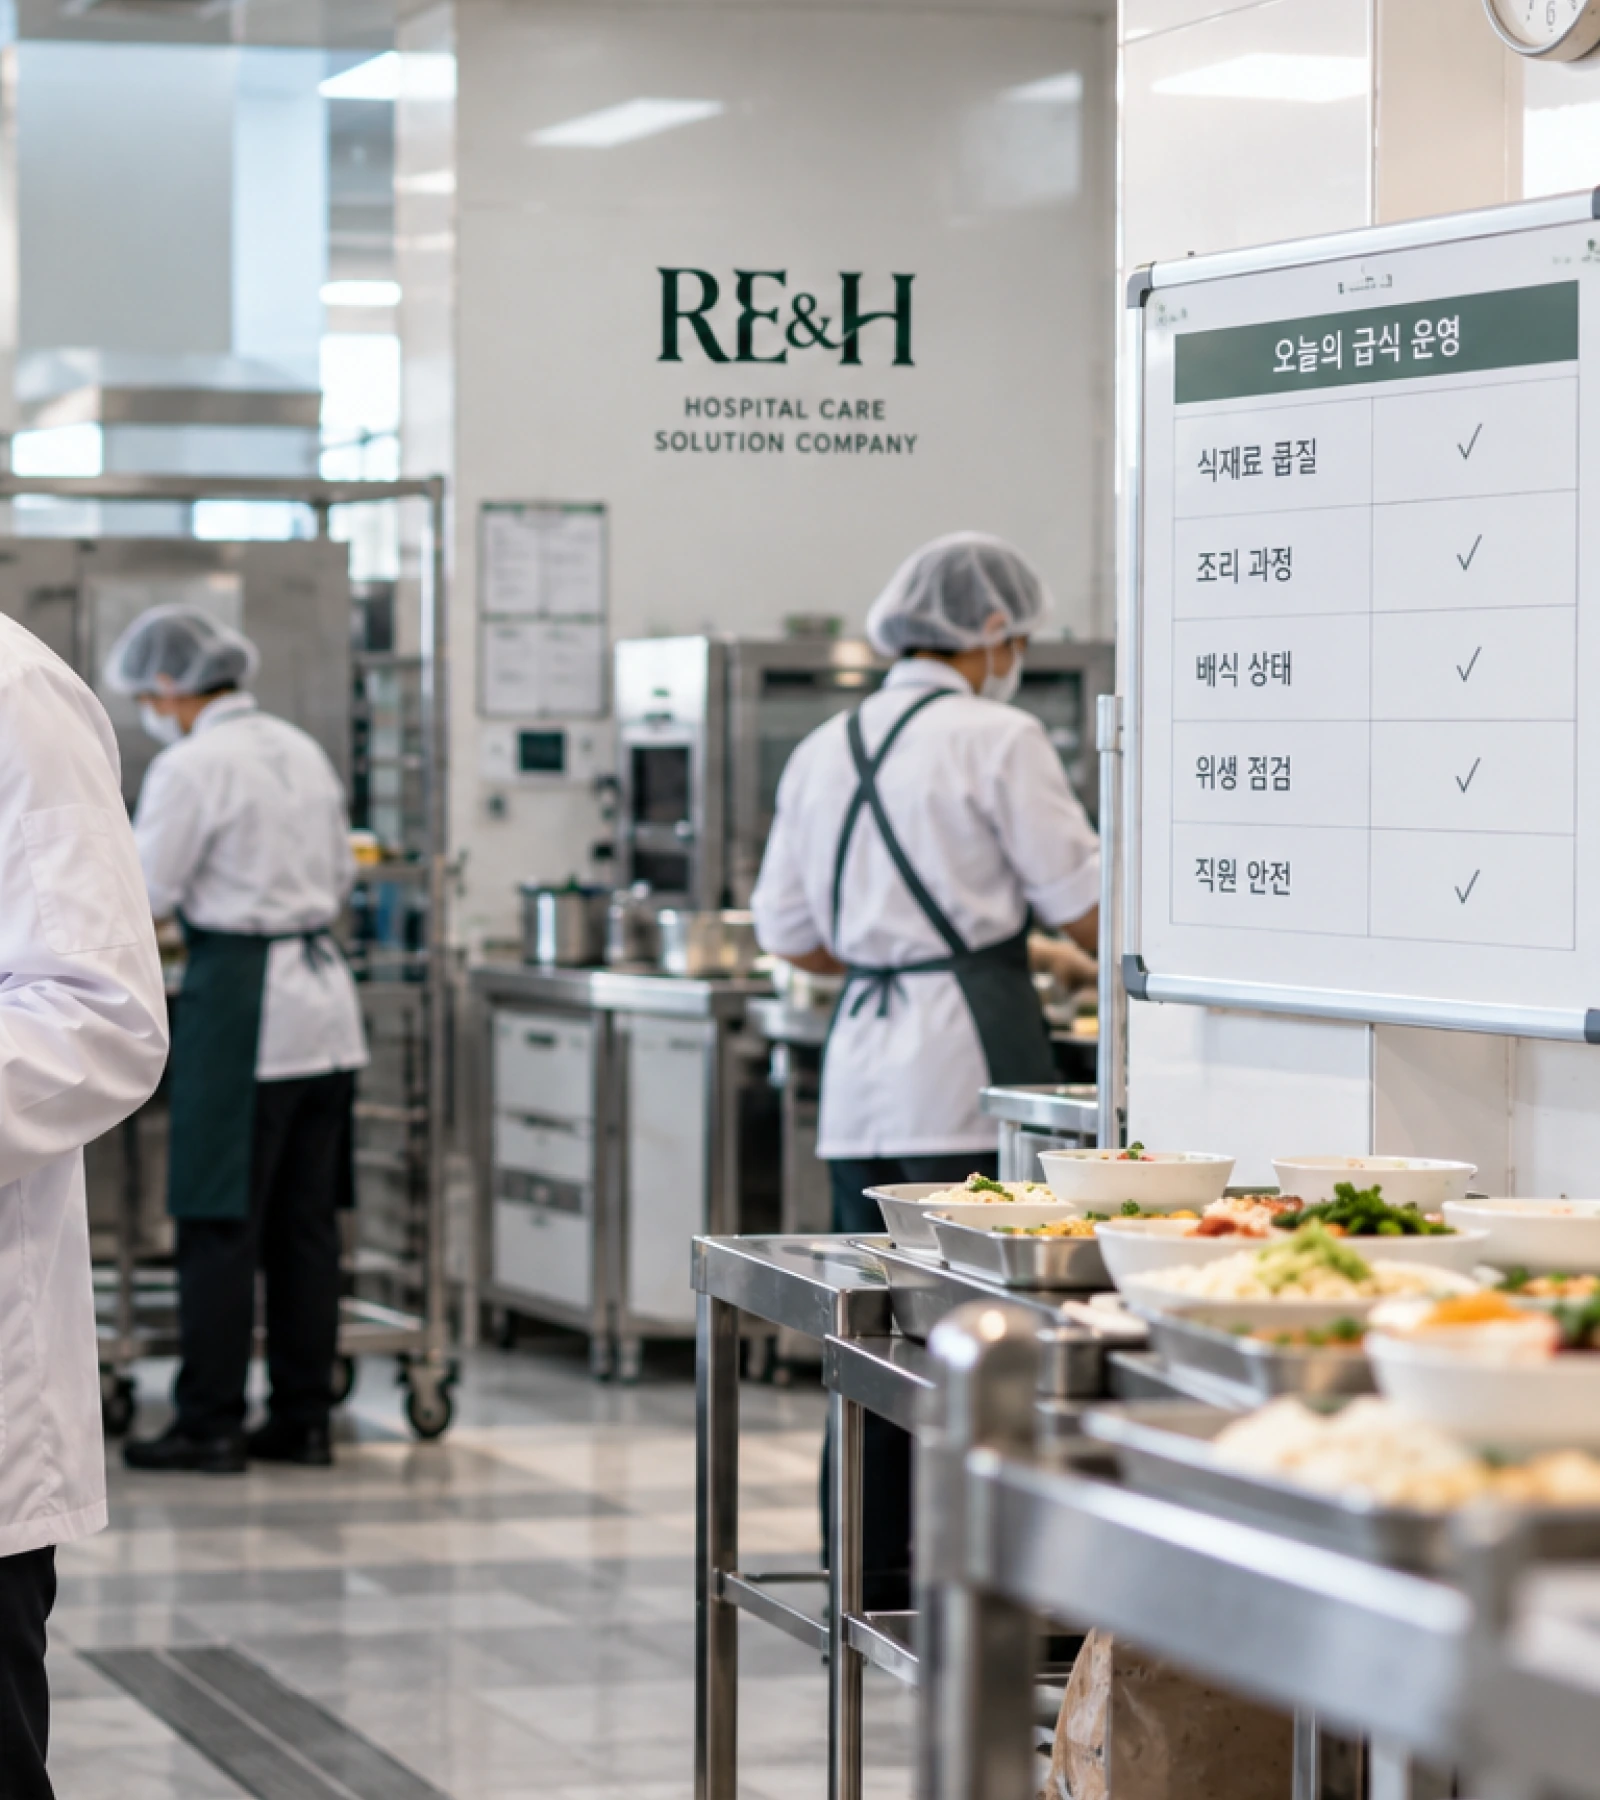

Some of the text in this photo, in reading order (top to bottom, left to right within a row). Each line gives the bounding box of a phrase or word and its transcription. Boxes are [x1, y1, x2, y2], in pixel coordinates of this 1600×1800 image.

[658, 267, 916, 367] RE&H
[1272, 314, 1460, 373] 오늘의 급식 운영
[685, 396, 885, 421] HOSPITAL CARE
[655, 431, 918, 454] SOLUTION COMPANY
[1197, 445, 1264, 483] 식재료
[1197, 546, 1291, 583] 조리 과정
[1196, 650, 1291, 688] 배식 상태
[1195, 754, 1291, 792] 위생 점검
[1195, 857, 1291, 896] 직원 안전
